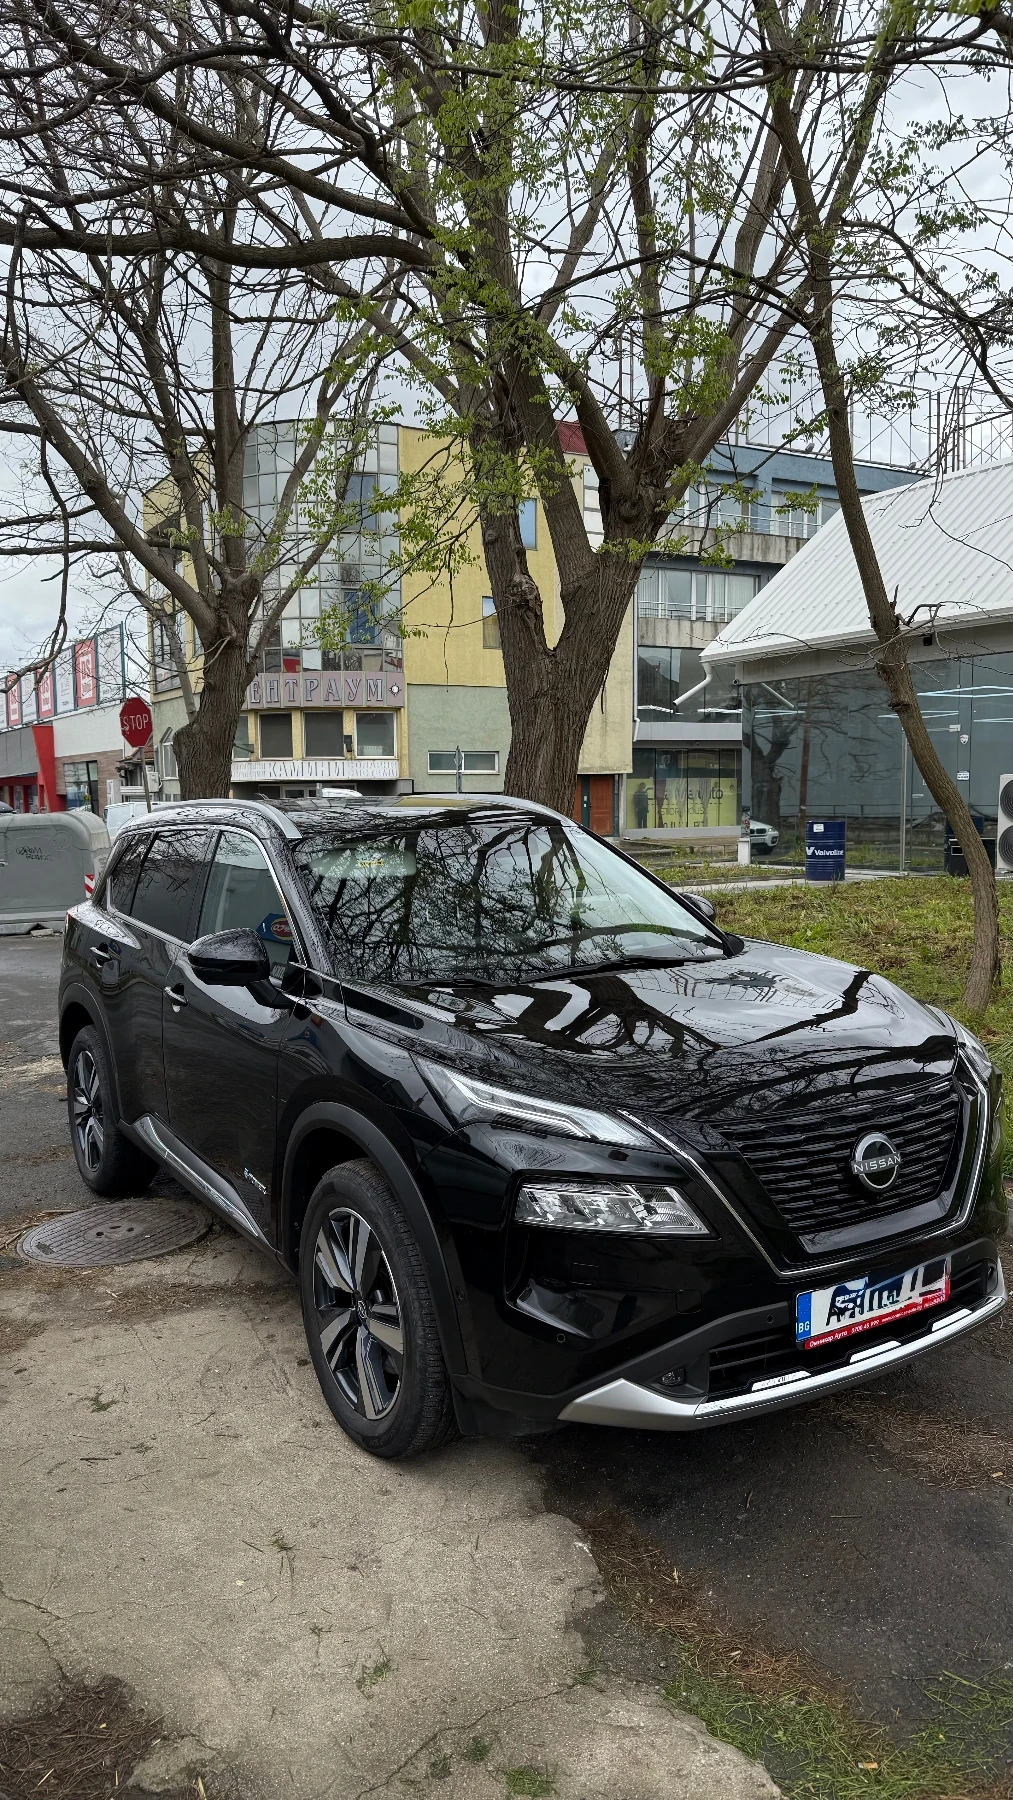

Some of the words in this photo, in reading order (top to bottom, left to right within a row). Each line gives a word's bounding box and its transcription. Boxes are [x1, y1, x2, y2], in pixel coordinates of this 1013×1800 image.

[250, 678, 384, 704] ЕНТРАУМ
[122, 713, 149, 731] STOP
[269, 761, 345, 777] КАМИНИ
[854, 1154, 901, 1172] NISSAN
[798, 1321, 810, 1333] BG
